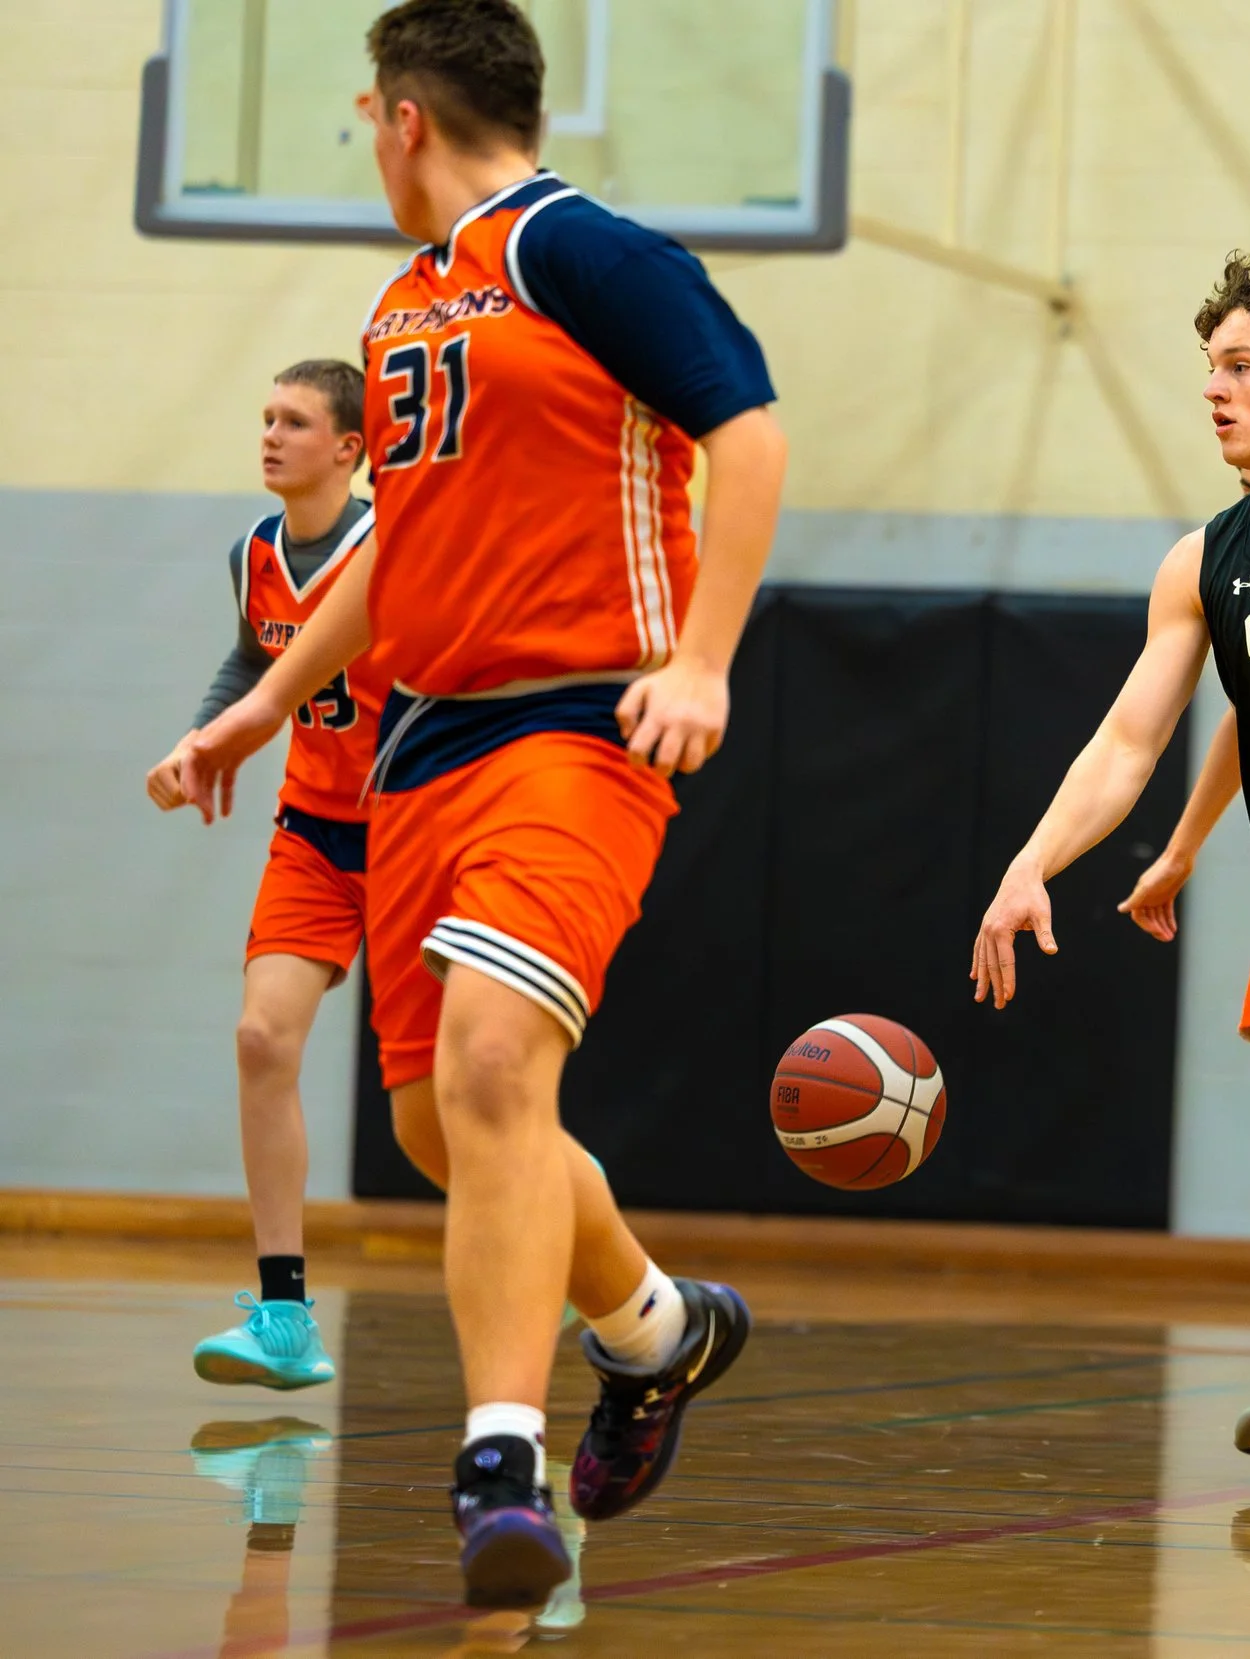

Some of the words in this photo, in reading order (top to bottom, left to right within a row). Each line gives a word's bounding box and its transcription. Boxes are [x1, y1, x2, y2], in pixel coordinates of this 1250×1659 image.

[379, 331, 471, 473] 31
[784, 1041, 832, 1064] olten
[777, 1086, 800, 1105] FIBA
